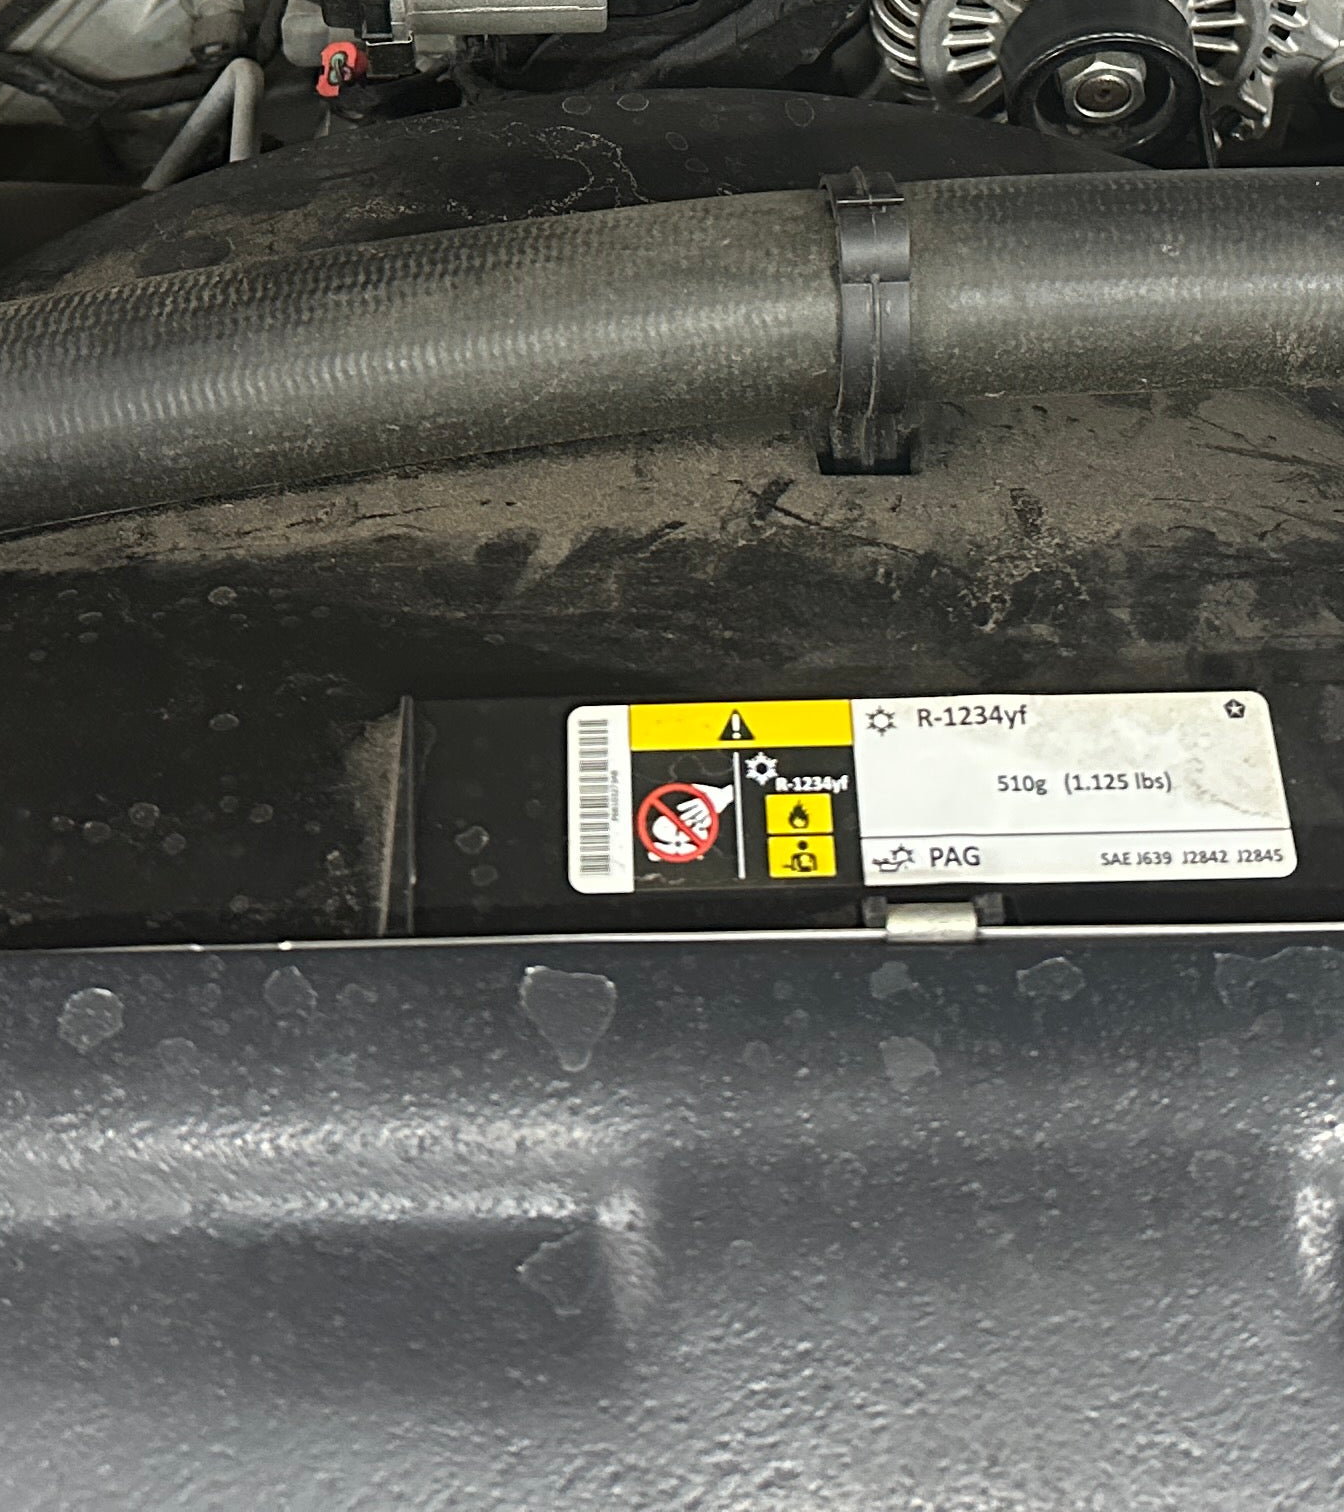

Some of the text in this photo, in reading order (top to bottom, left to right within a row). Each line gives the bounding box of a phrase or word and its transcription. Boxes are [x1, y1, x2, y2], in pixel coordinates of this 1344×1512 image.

[916, 703, 1030, 730] R-1234yf
[774, 774, 850, 795] R-1234yf
[996, 770, 1174, 797] 510g (1.125 lbs)
[928, 845, 982, 868] PAG
[1099, 848, 1285, 867] SAE J639 J2842 J2845
